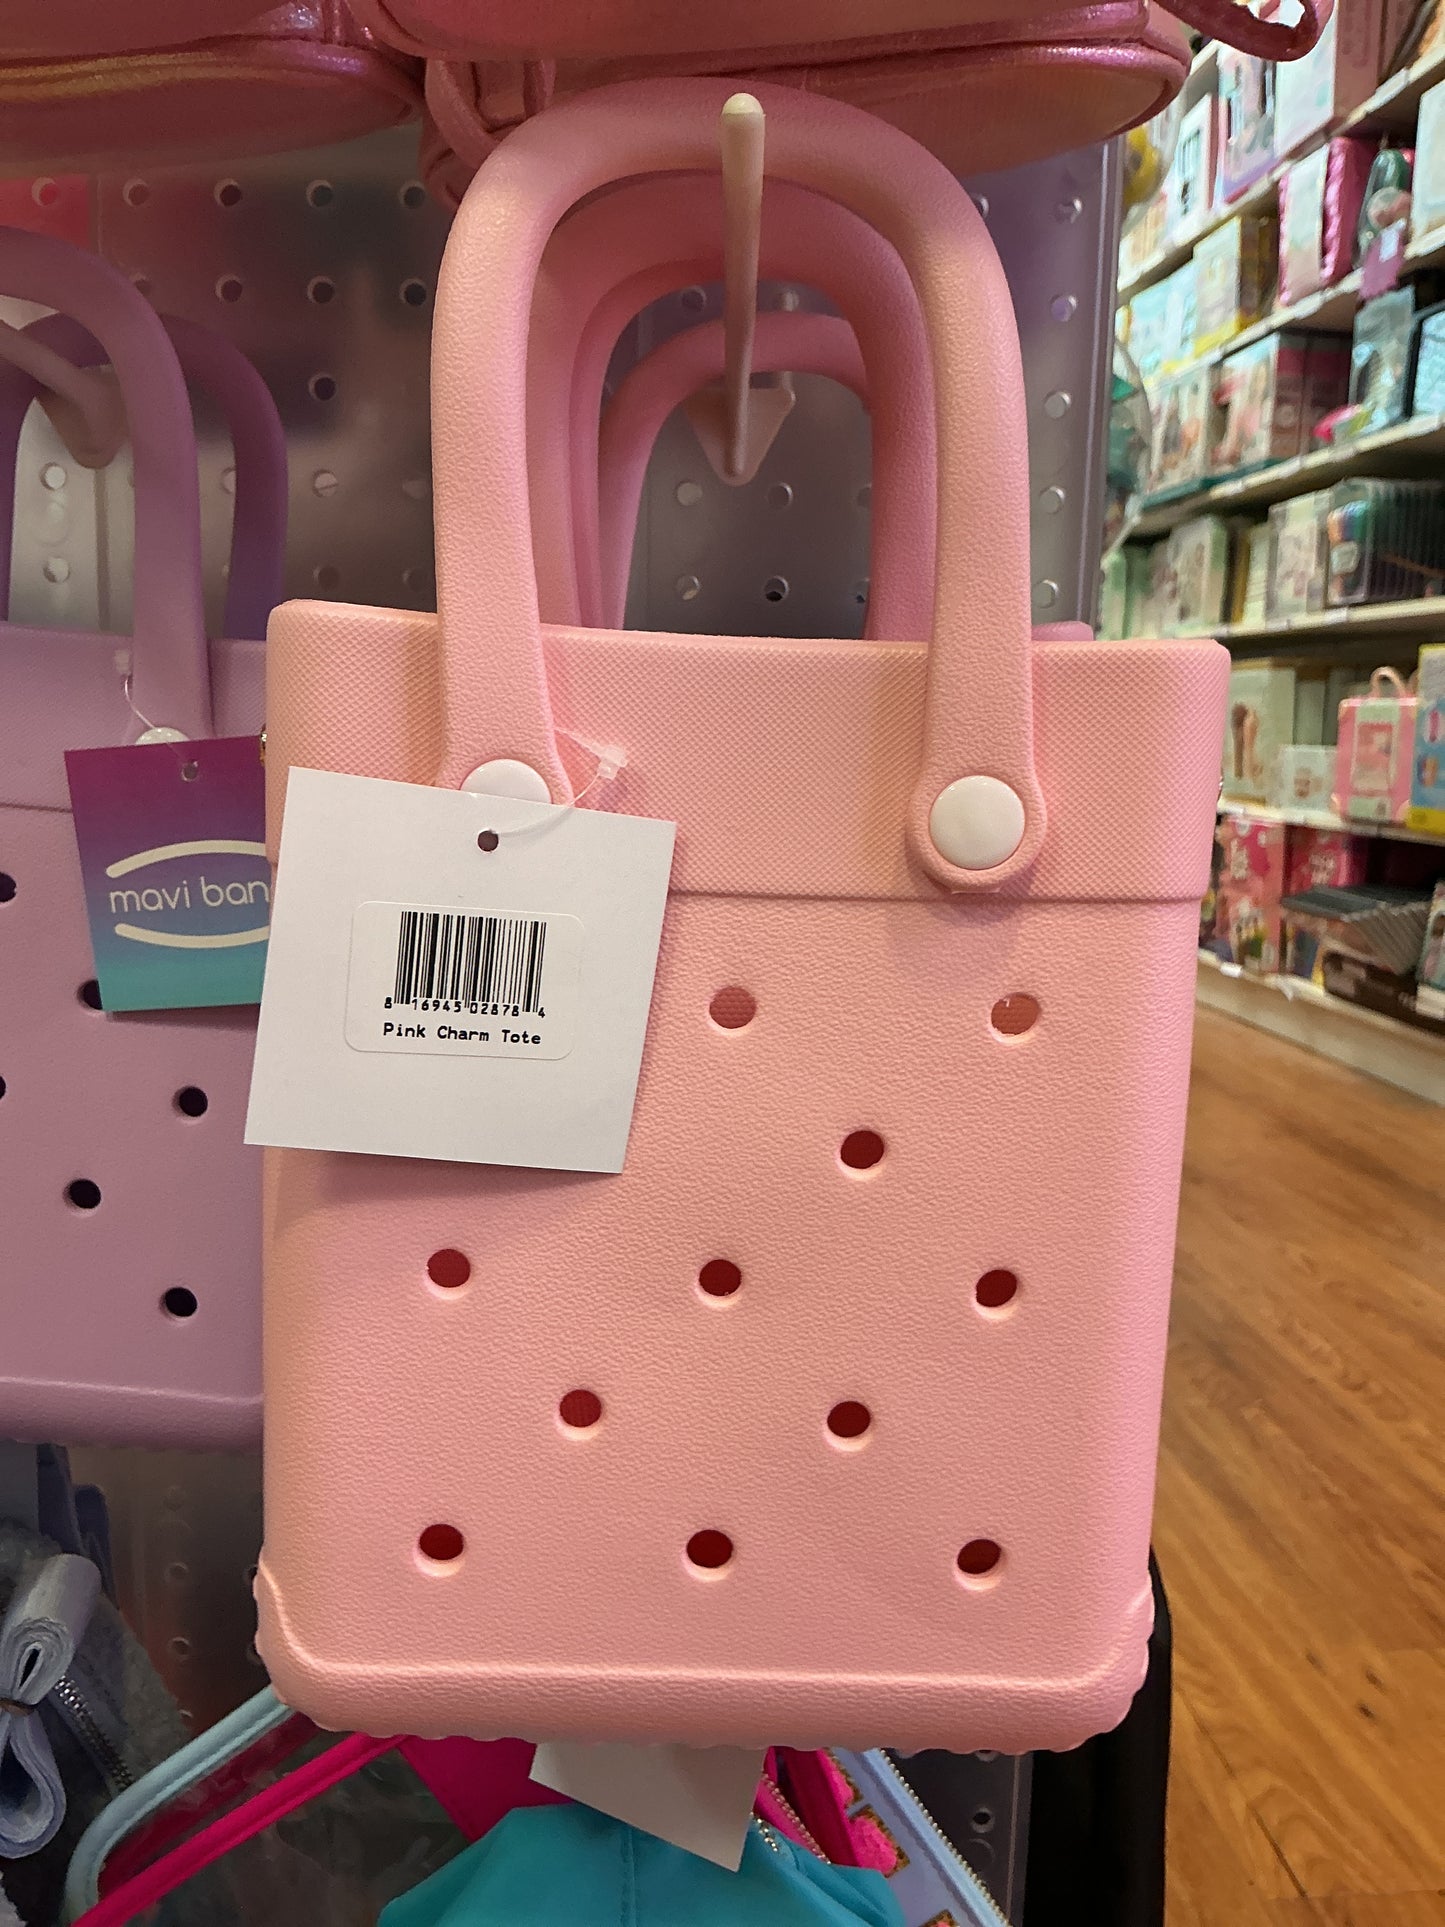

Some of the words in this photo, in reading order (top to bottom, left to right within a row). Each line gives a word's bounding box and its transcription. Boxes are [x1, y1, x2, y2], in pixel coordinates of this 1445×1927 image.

[109, 880, 191, 913] mavi
[383, 1022, 426, 1038] Pink
[437, 1025, 489, 1042] Charm
[502, 1029, 541, 1045] Tote
